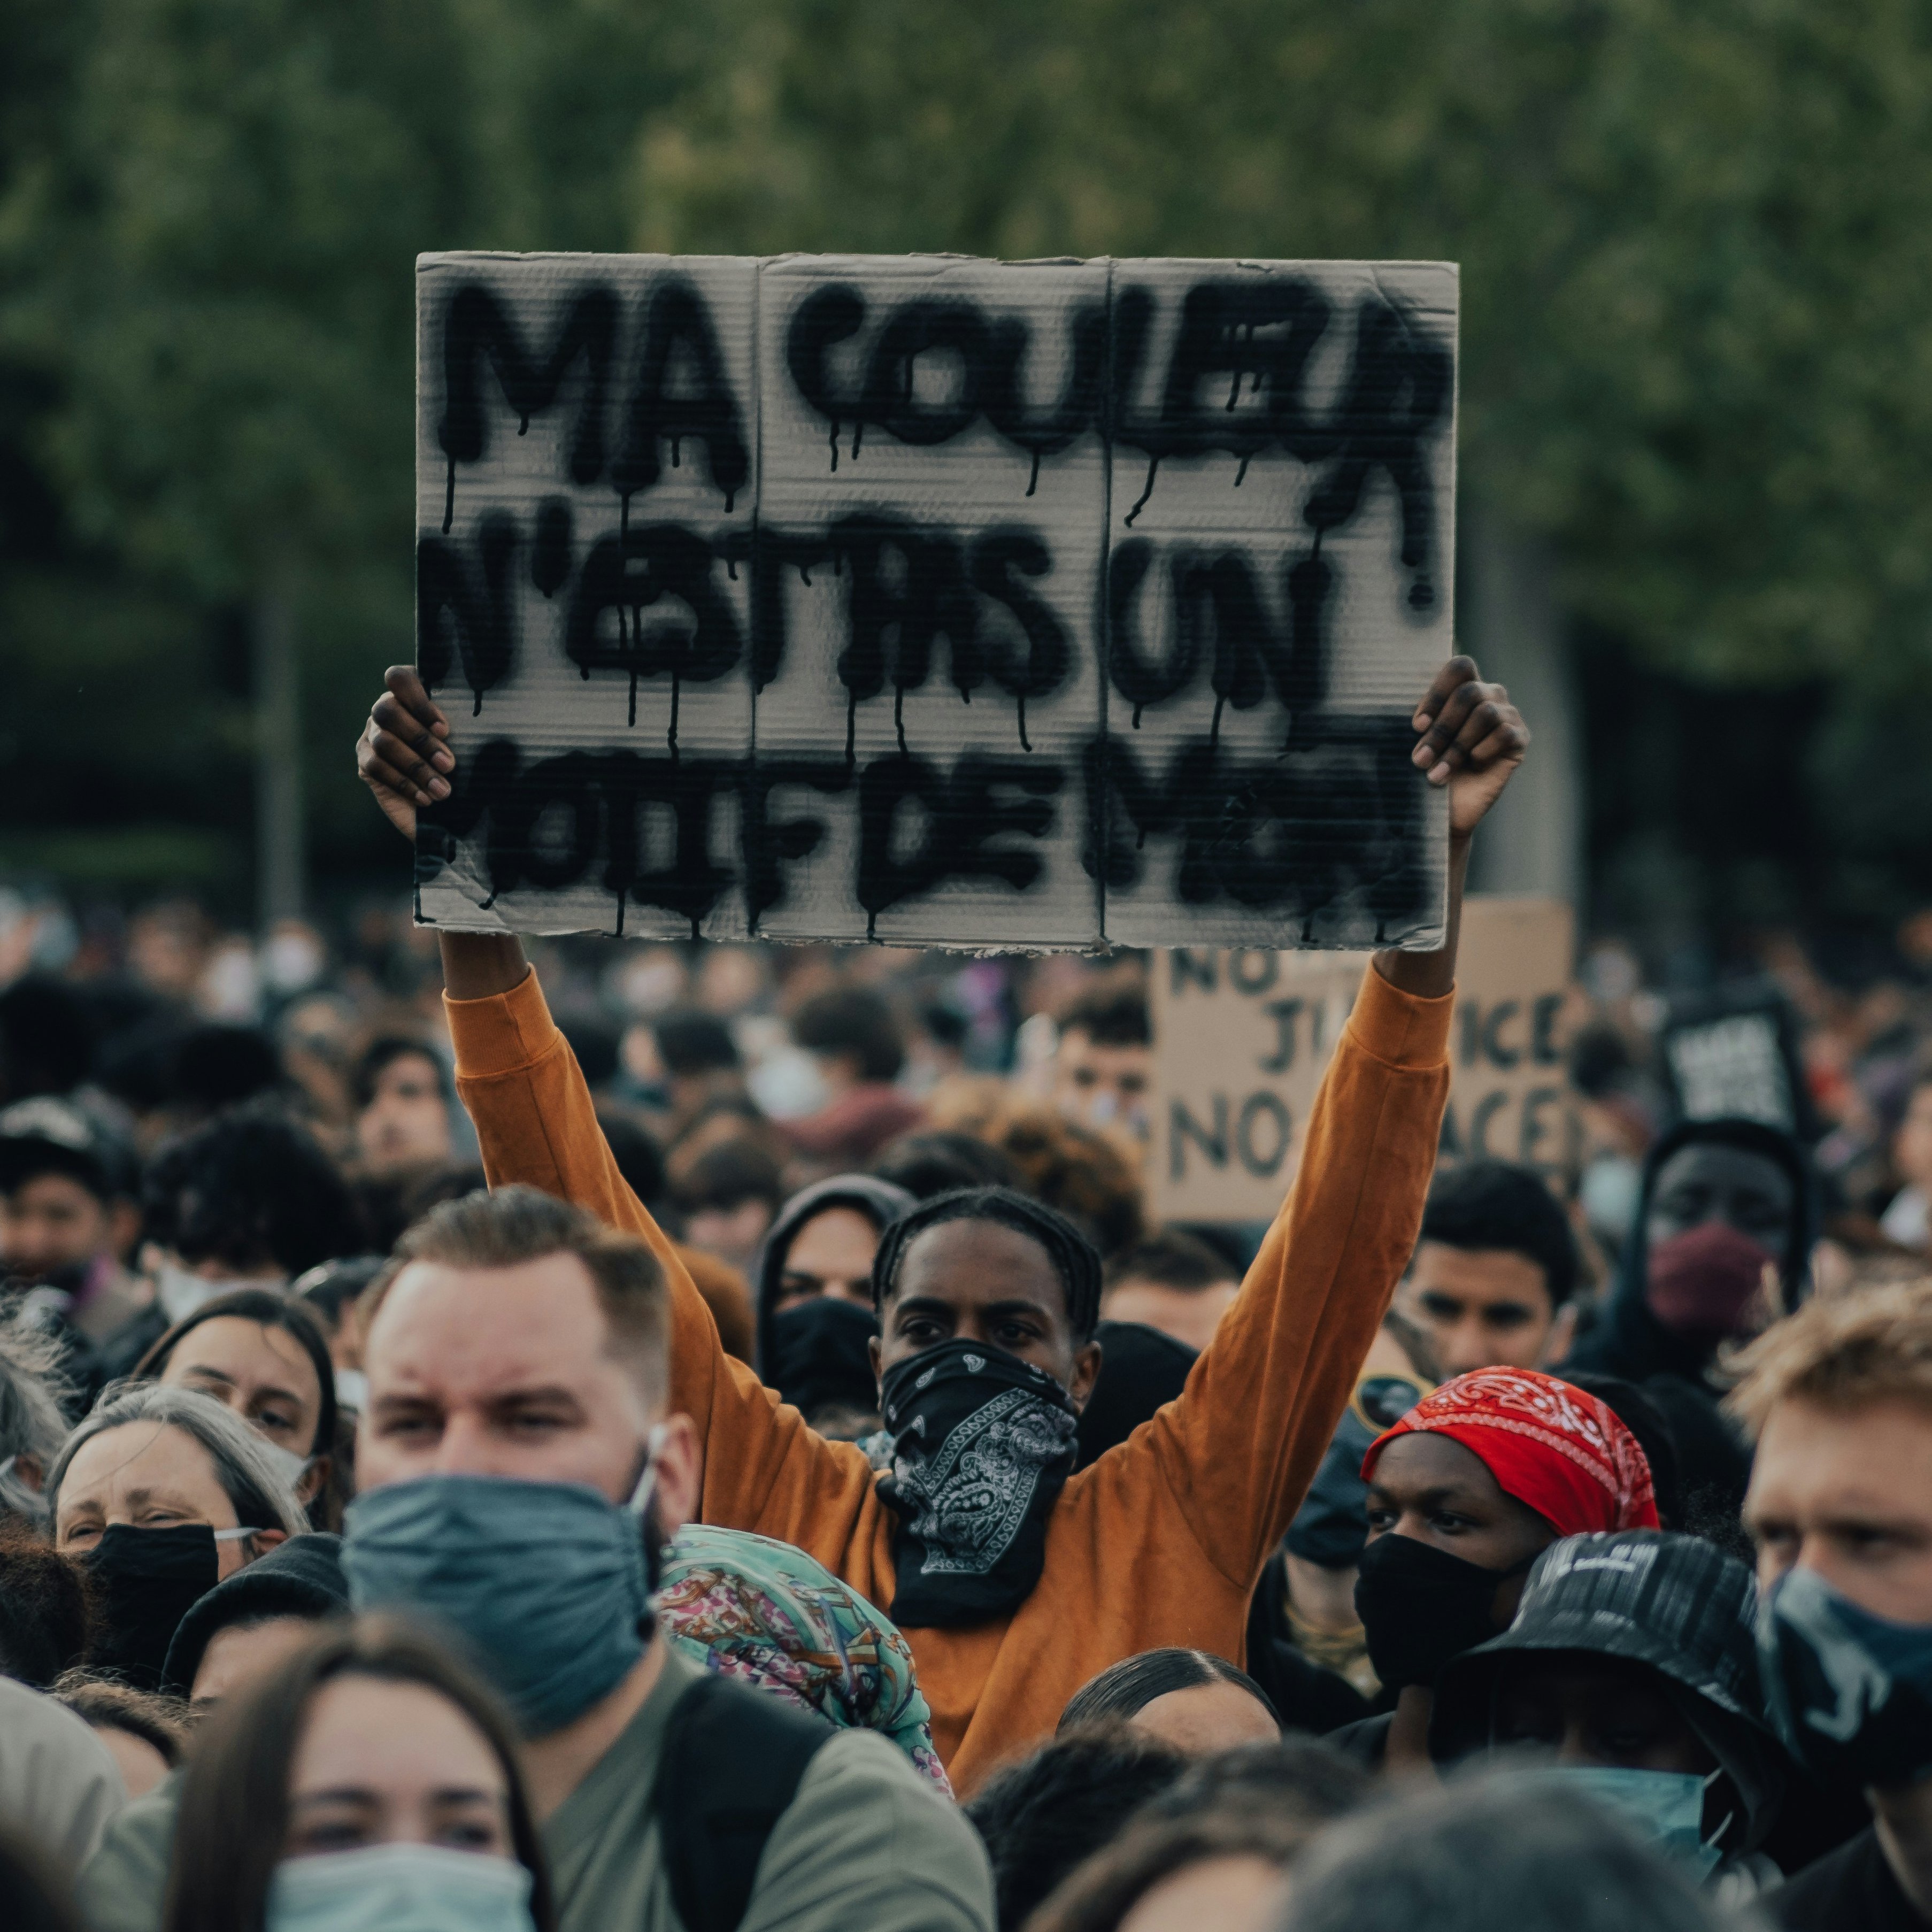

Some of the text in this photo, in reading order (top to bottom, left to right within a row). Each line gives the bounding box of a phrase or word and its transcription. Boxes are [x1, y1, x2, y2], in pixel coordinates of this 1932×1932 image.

[436, 279, 1453, 567] MA COULEUR
[830, 513, 1072, 701] PAS
[1107, 537, 1333, 711] UN
[857, 757, 1065, 912] DE
[1168, 949, 1280, 996] NO
[1168, 1088, 1292, 1182] NO
